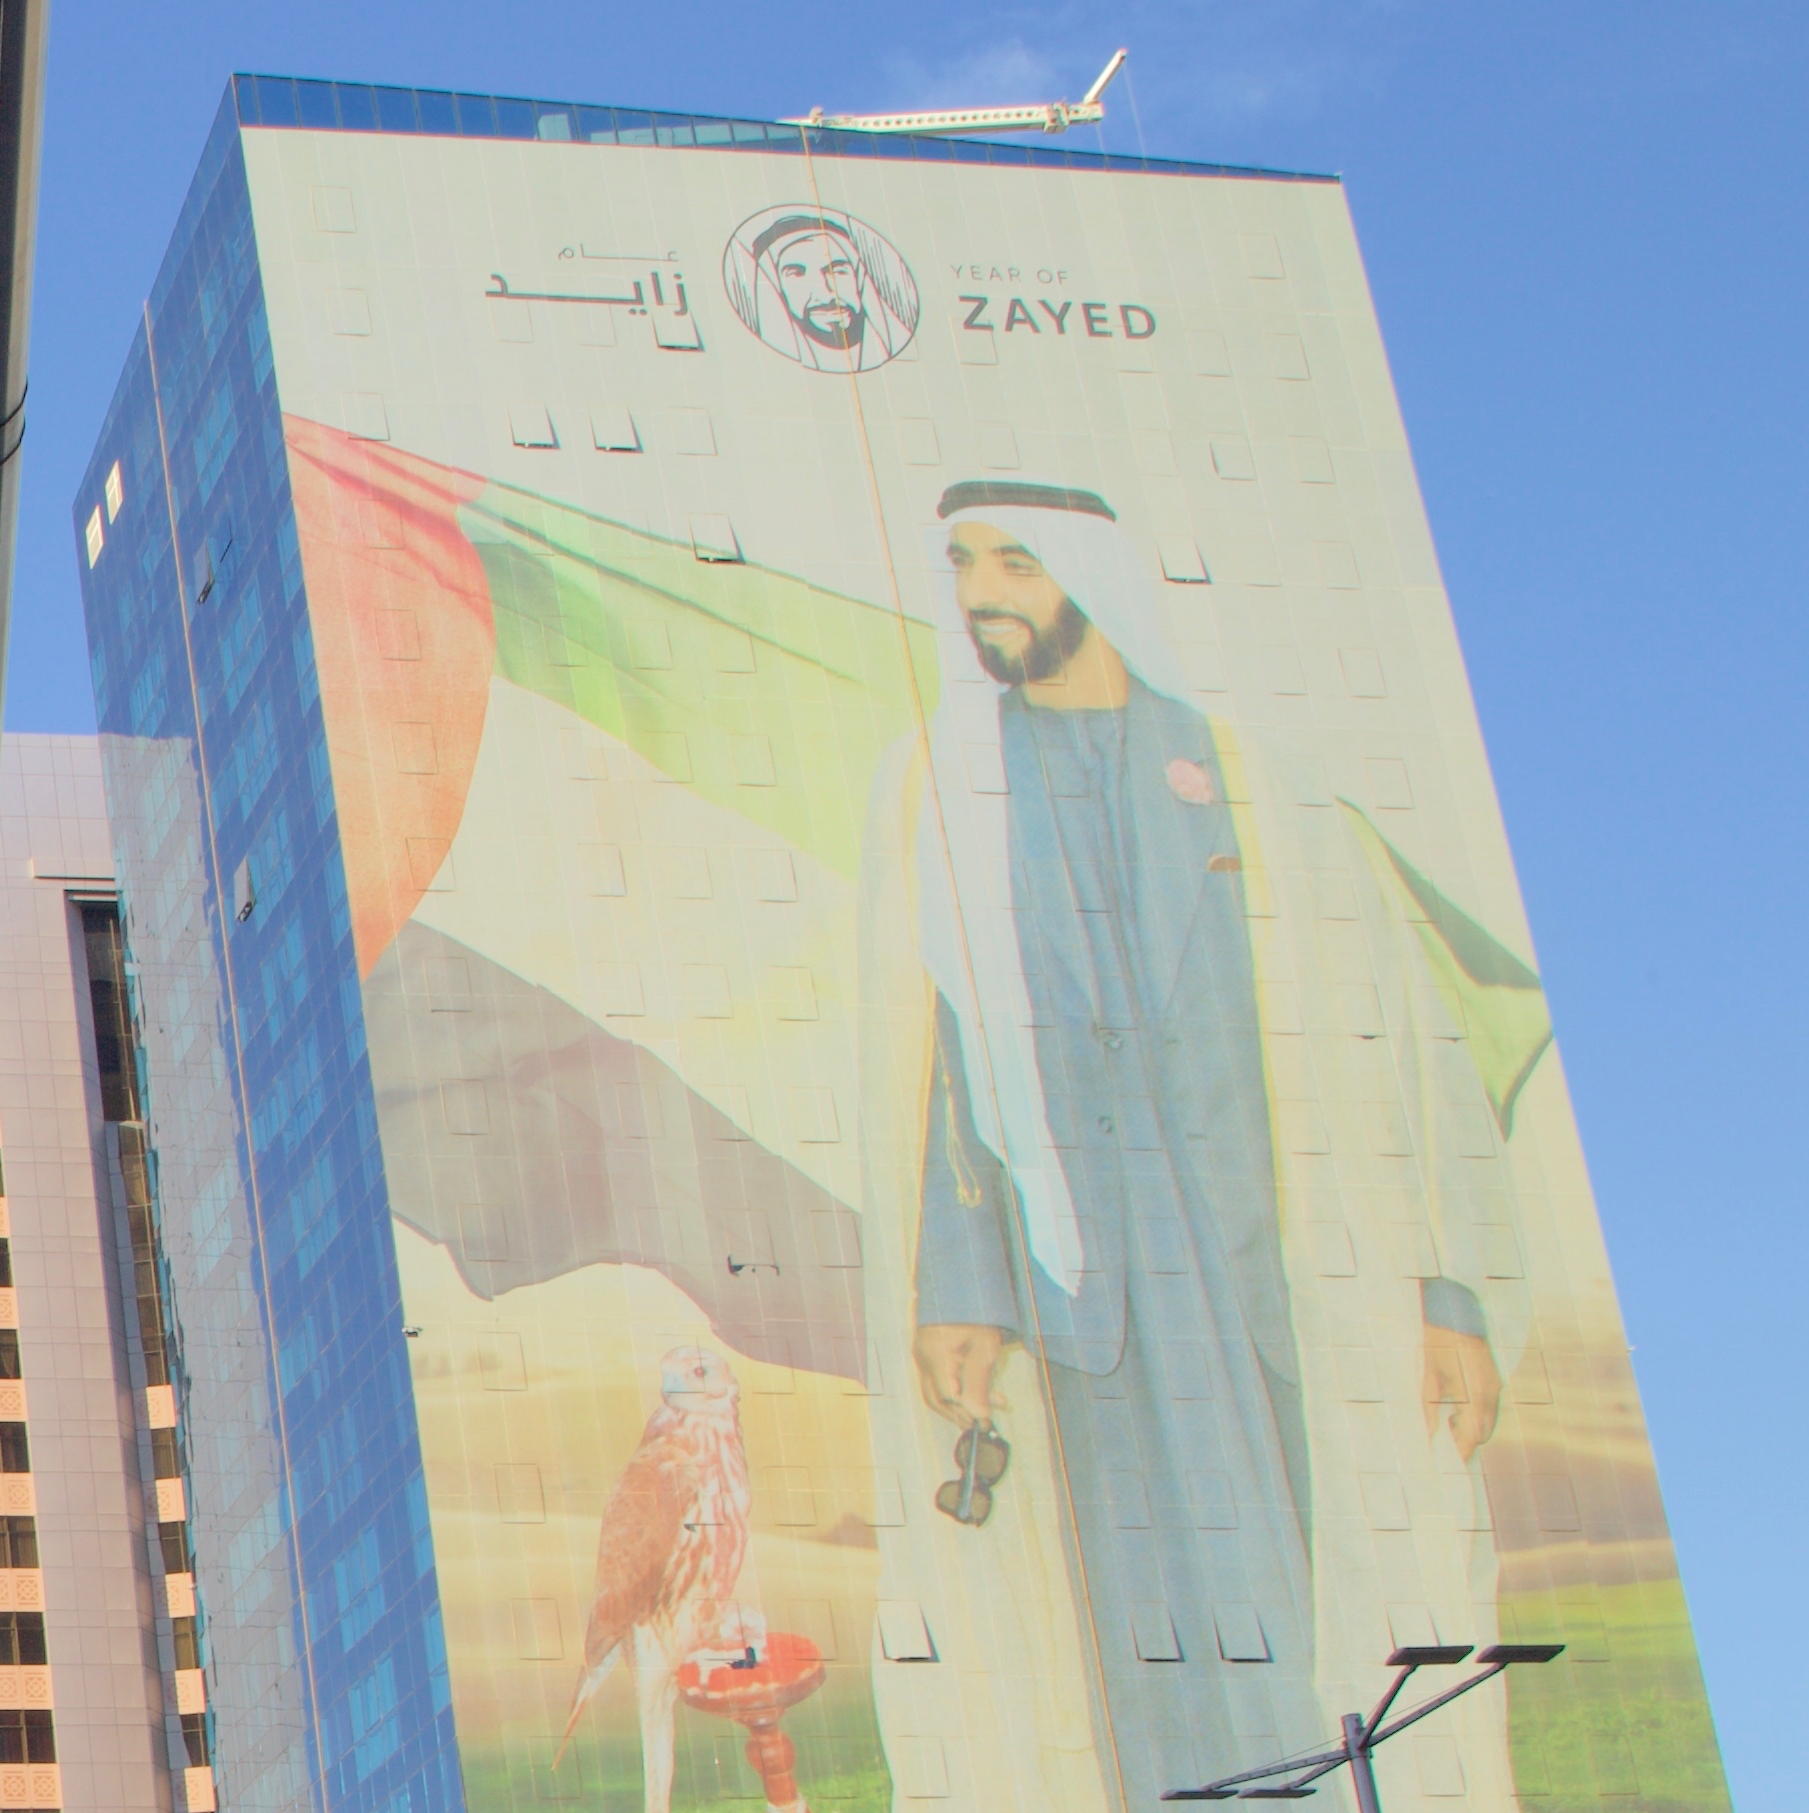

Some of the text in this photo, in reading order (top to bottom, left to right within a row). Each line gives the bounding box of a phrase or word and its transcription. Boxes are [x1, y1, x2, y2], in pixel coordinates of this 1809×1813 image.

[557, 243, 679, 262] عام
[950, 264, 1069, 286] YEAR OF
[485, 271, 688, 316] زايد
[958, 295, 1157, 340] ZAYED
